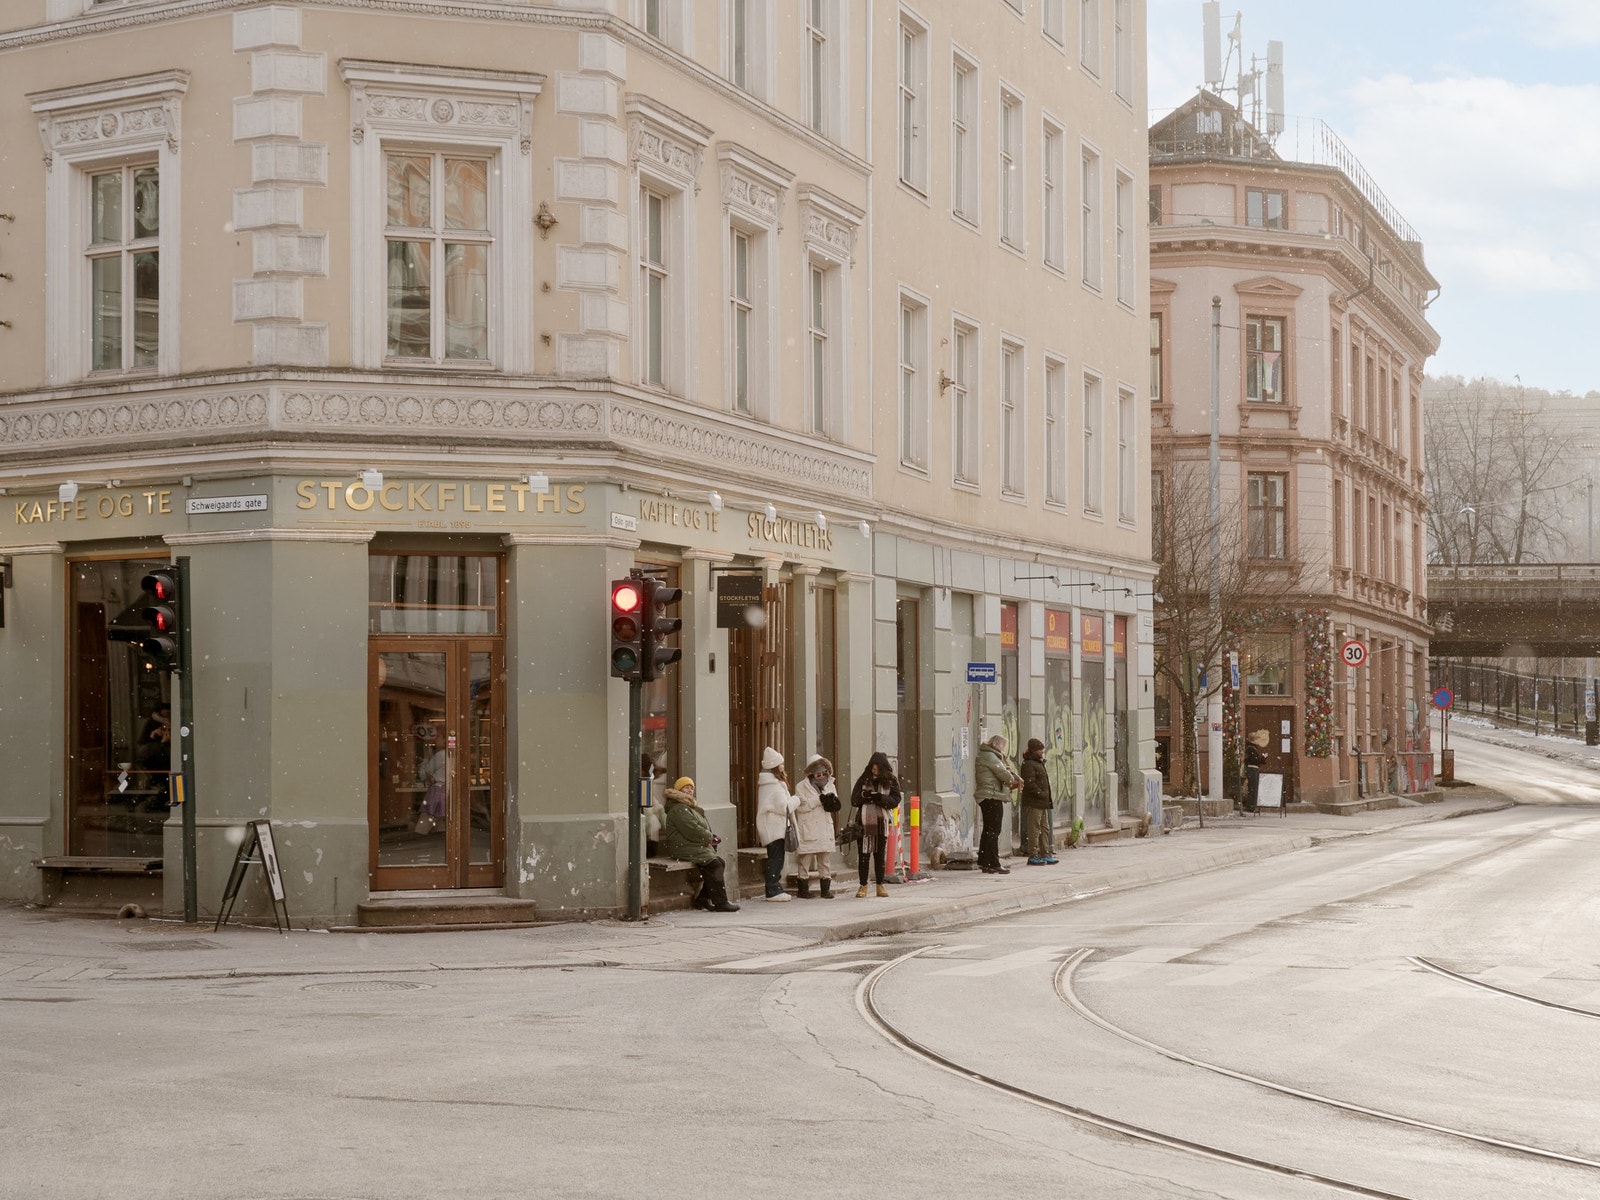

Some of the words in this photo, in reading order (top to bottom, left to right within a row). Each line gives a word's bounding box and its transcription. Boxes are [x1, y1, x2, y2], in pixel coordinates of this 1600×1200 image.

[15, 499, 88, 525] KAFFE
[97, 494, 134, 518] OG
[143, 490, 172, 515] TE
[191, 499, 242, 511] Schweigaards
[245, 499, 262, 509] gate
[296, 480, 586, 514] STOCKFLETHS
[639, 499, 679, 526] KAFFE
[683, 508, 701, 530] OG
[704, 511, 719, 533] TE
[747, 512, 833, 551] STOCKFLETHS
[1346, 647, 1363, 660] 30
